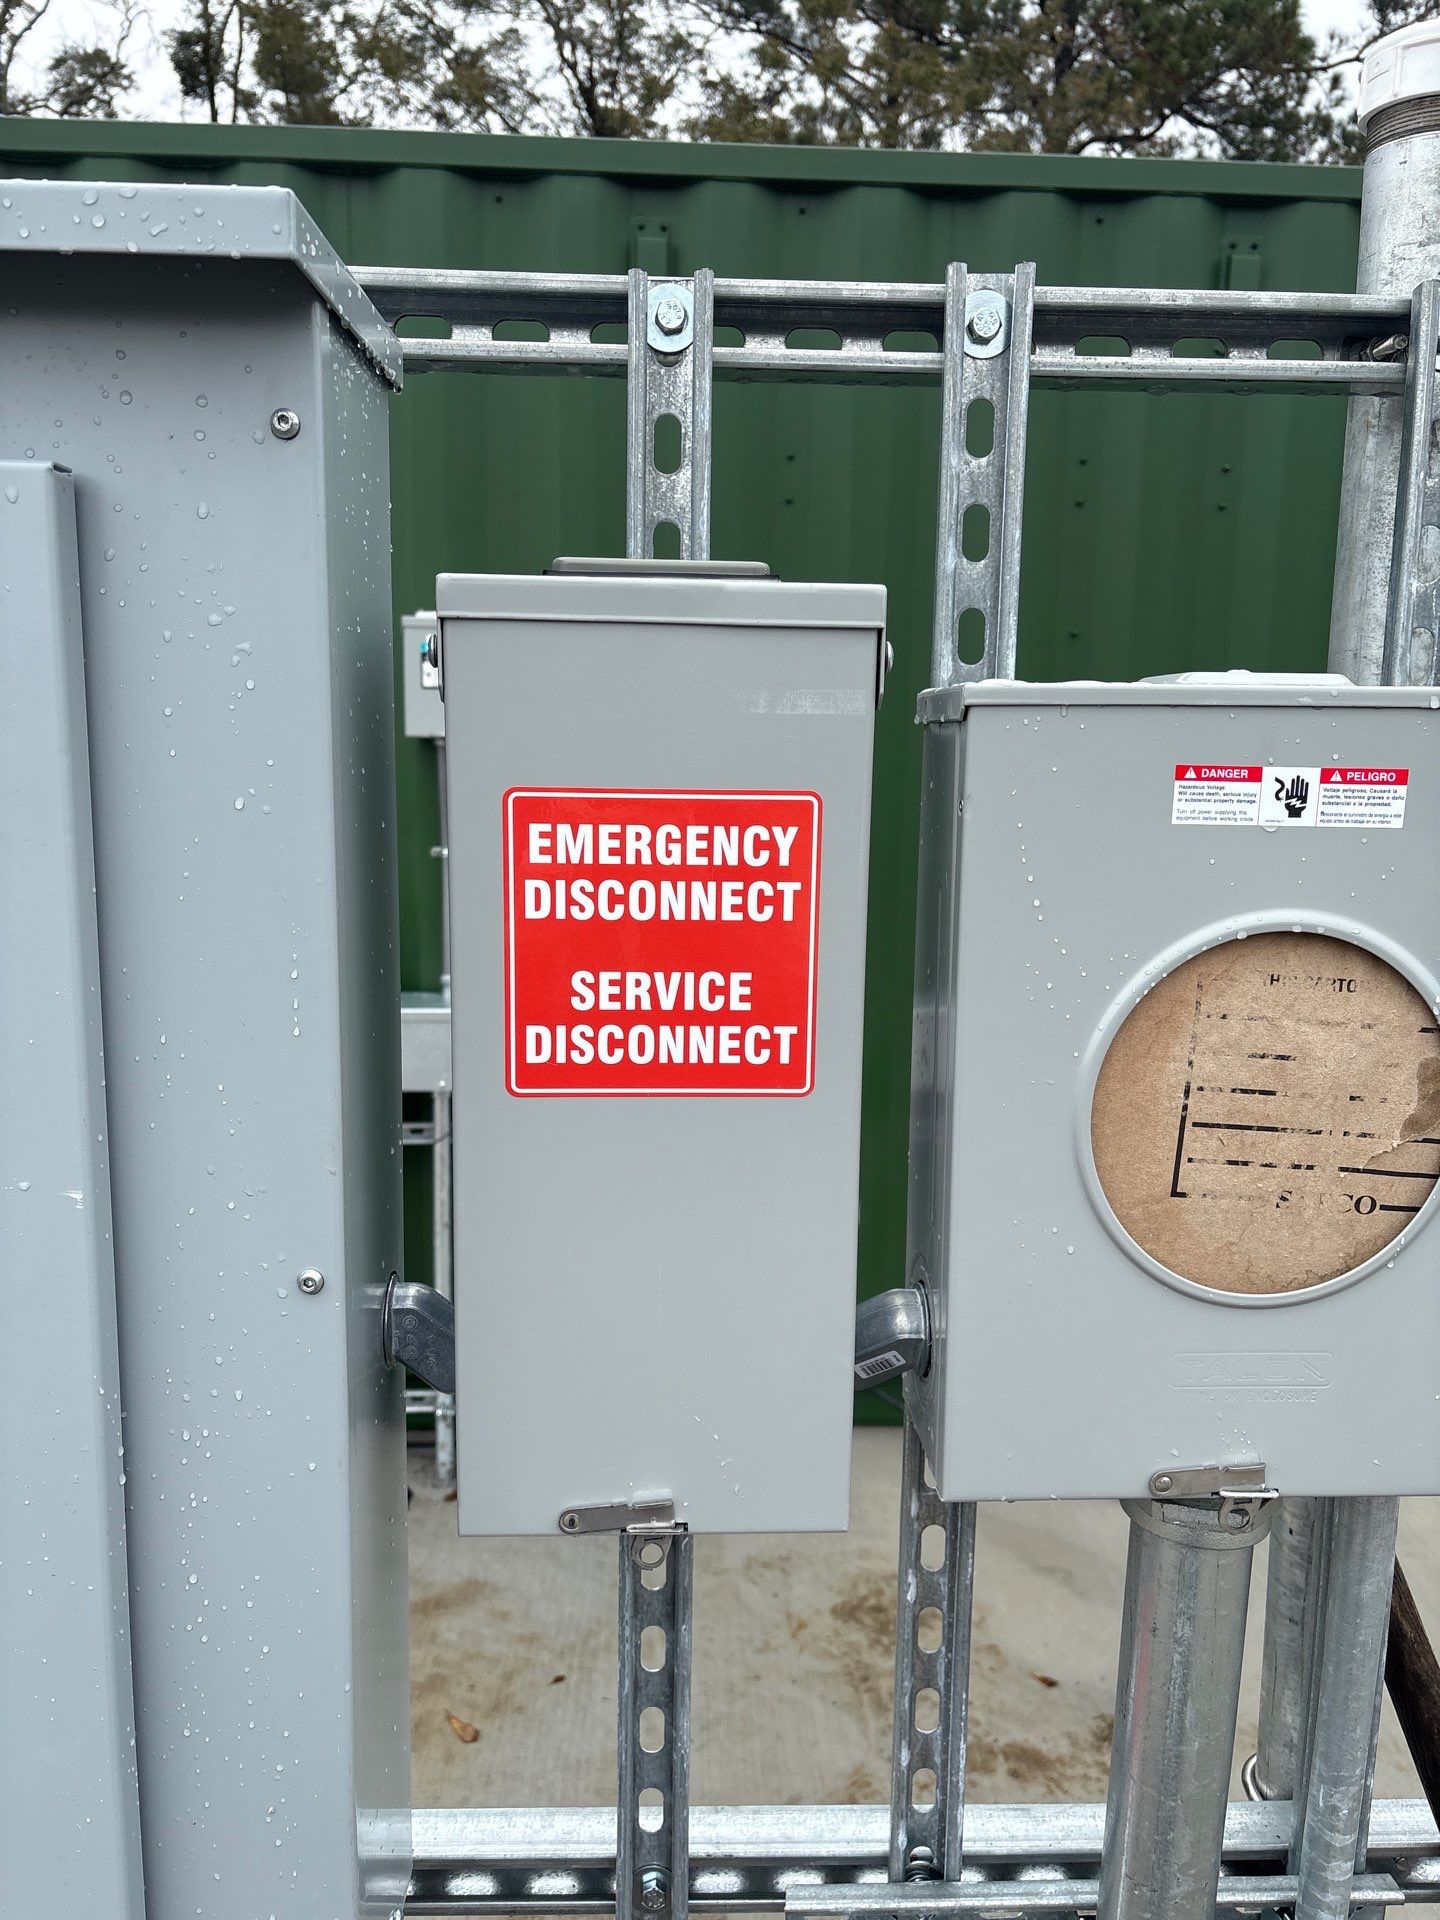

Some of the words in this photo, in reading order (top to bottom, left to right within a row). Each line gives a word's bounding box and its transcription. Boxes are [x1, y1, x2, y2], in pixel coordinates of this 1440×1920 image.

[1201, 768, 1248, 779] DANGER
[1346, 772, 1396, 782] PELIGRO
[527, 822, 799, 867] EMERGENCY
[523, 878, 802, 922] DISCONNECT
[570, 970, 752, 1011] SERVICE
[525, 1024, 799, 1065] DISCONNECT
